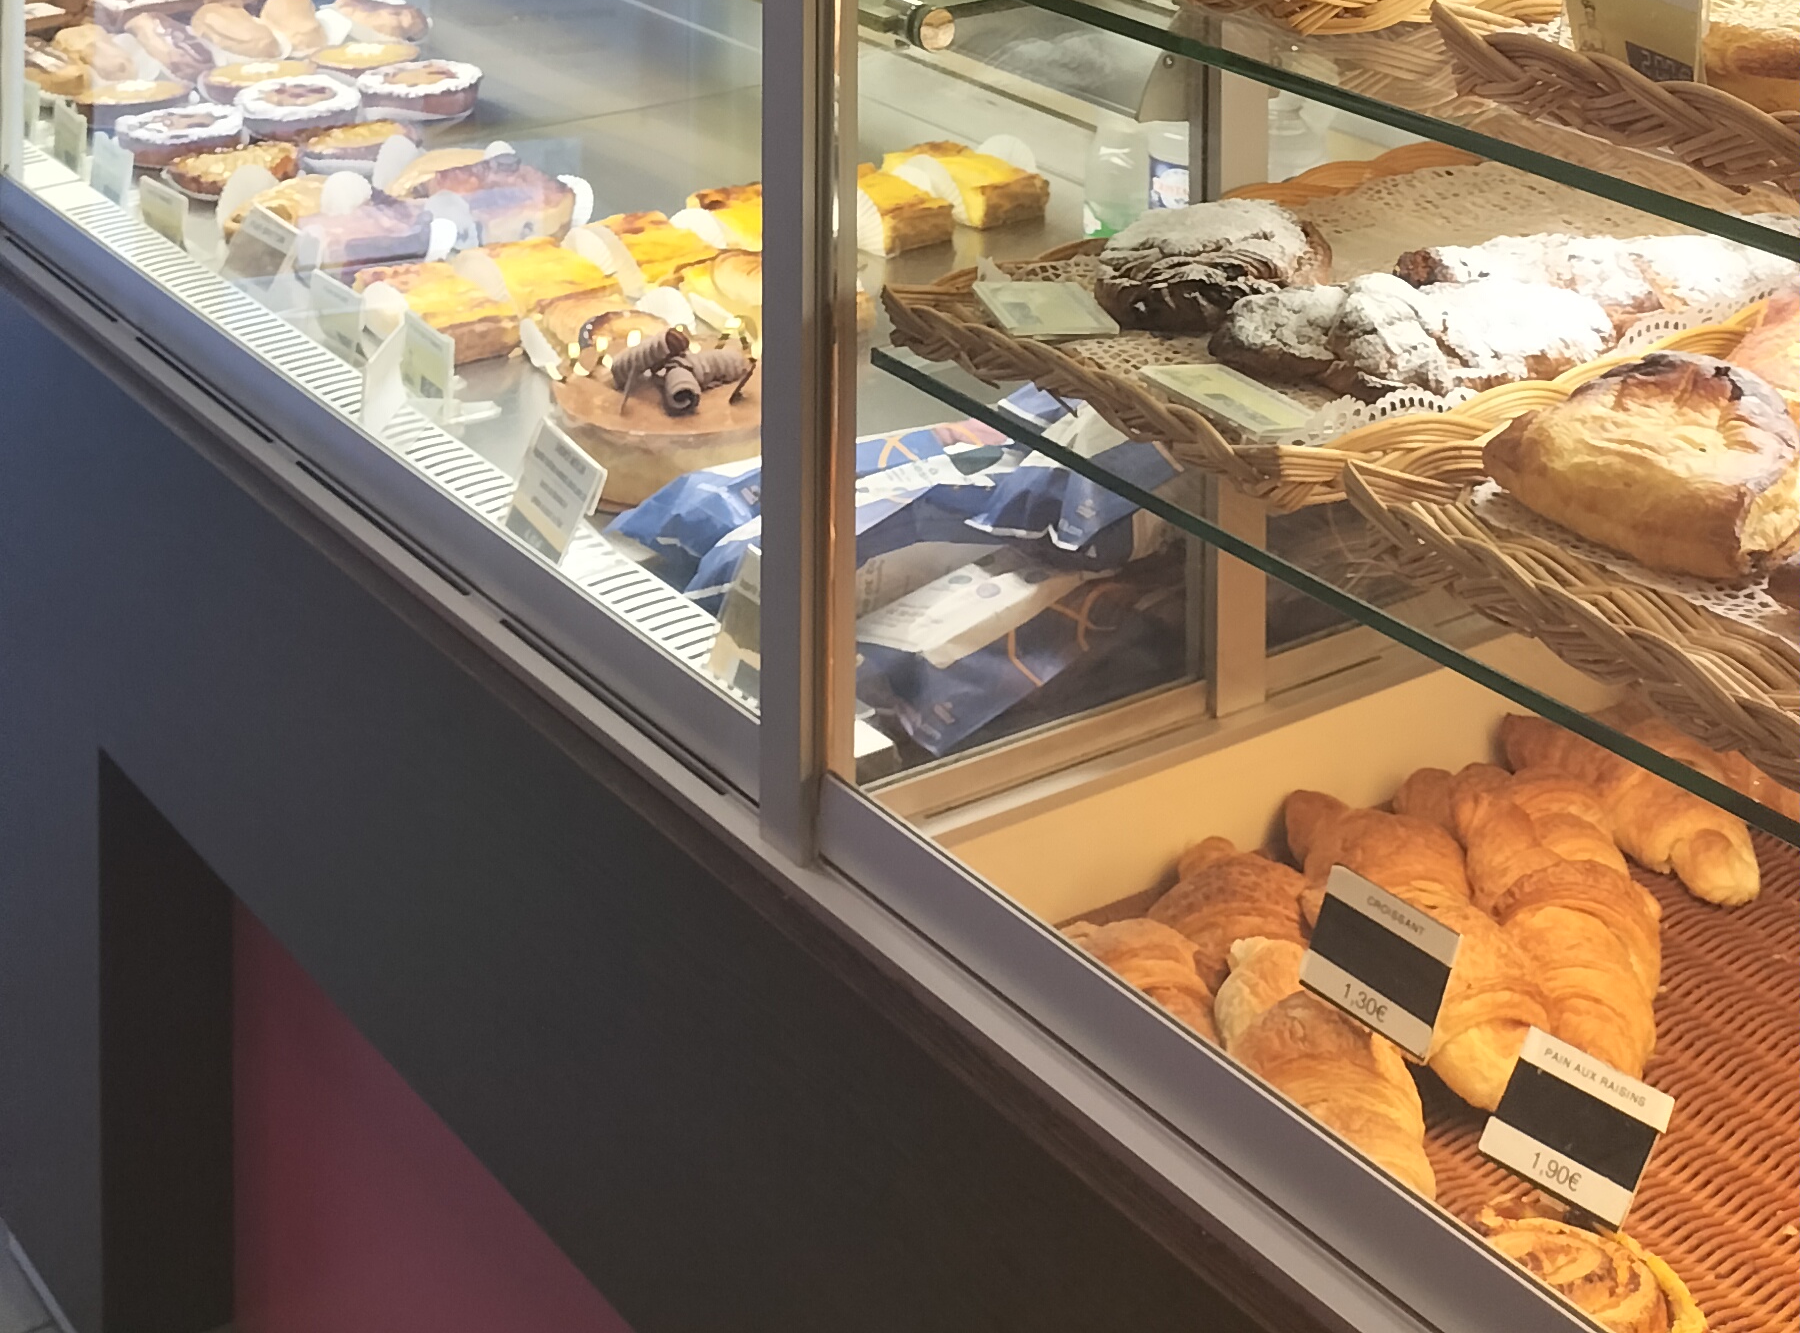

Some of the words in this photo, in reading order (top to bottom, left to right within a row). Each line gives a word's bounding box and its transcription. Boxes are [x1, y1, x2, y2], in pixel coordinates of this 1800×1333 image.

[1366, 895, 1425, 936] CROISSANT
[1343, 982, 1388, 1024] 1,30€
[1544, 1047, 1572, 1070] PAIN
[1573, 1062, 1598, 1083] AUX
[1600, 1074, 1646, 1108] RAISINS
[1530, 1151, 1582, 1192] 1,90€
